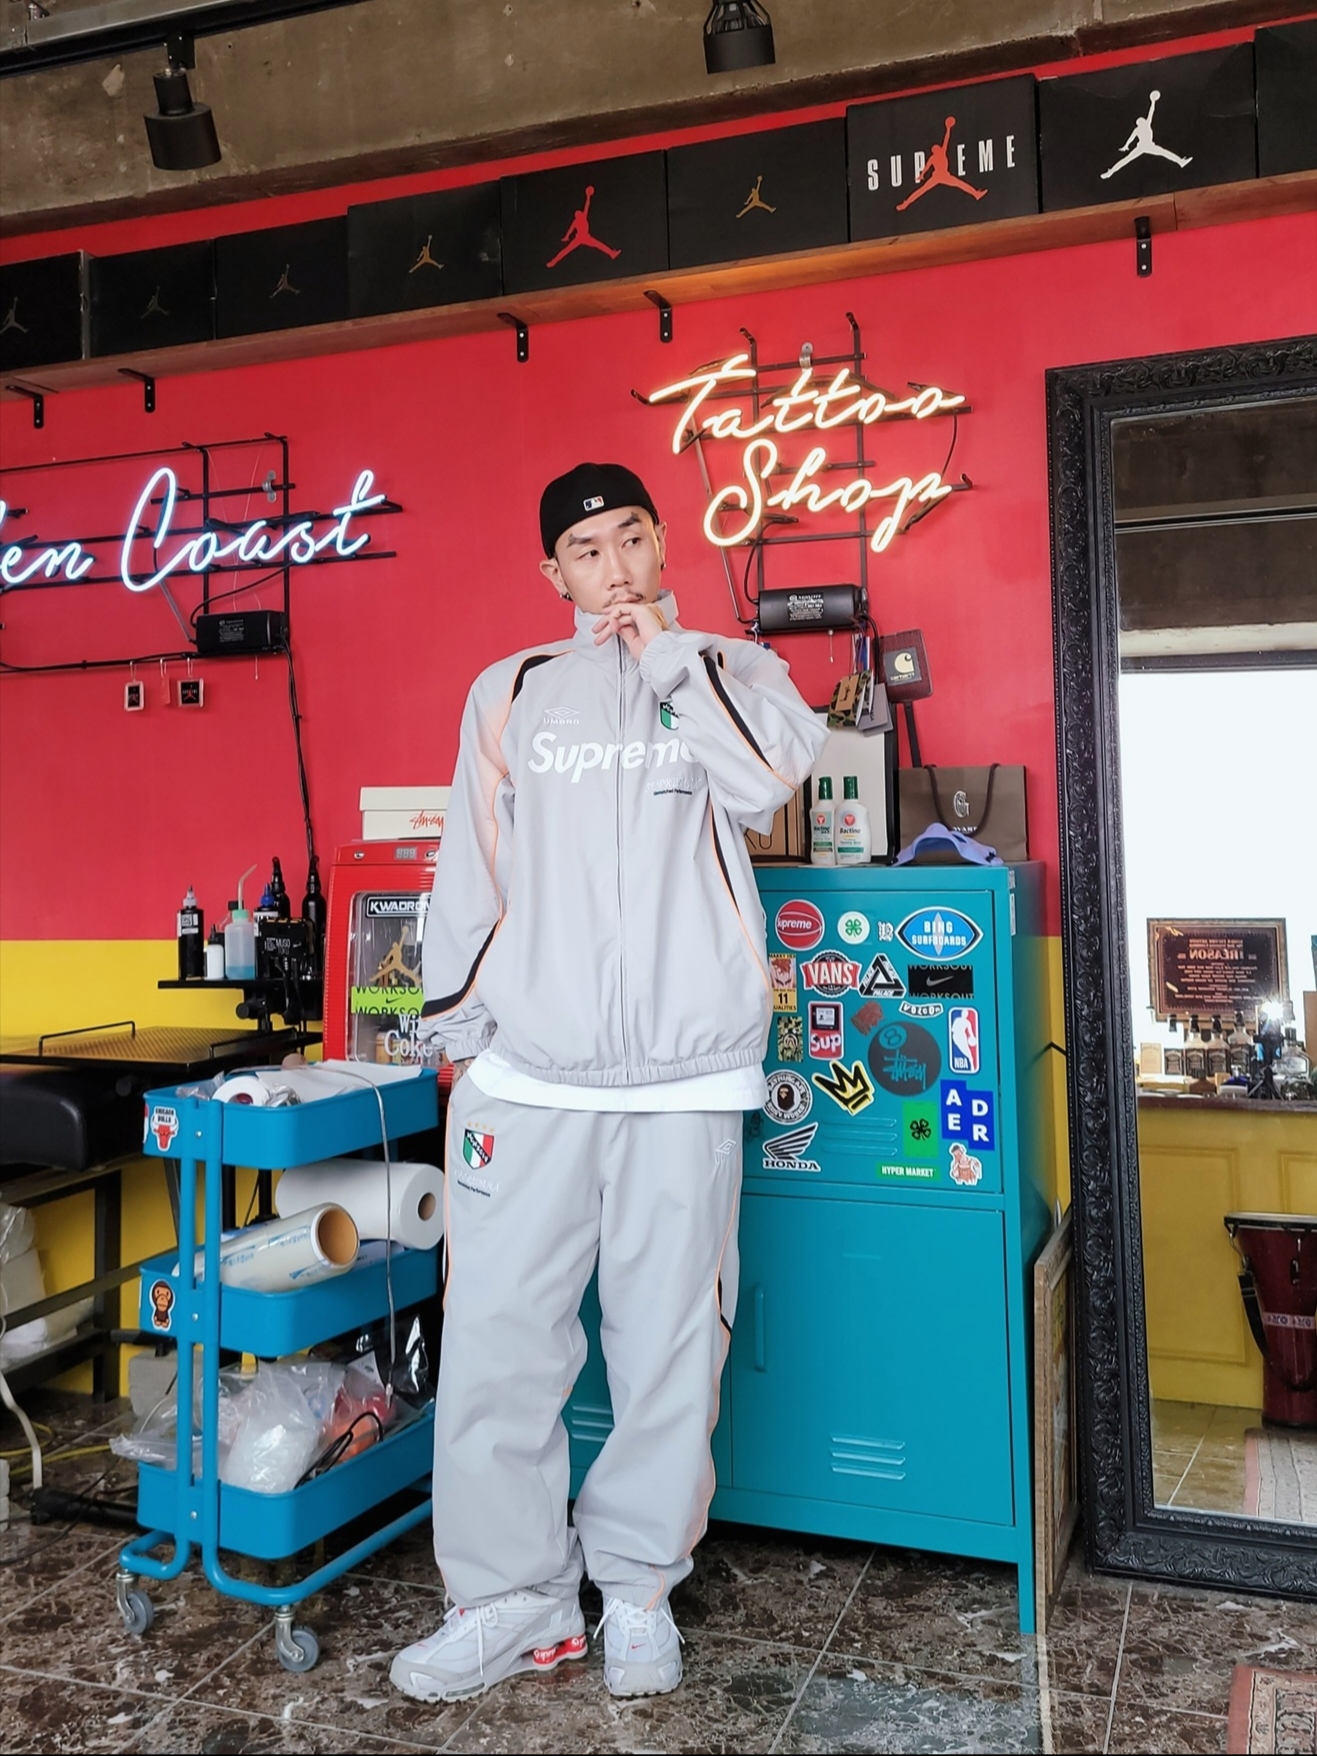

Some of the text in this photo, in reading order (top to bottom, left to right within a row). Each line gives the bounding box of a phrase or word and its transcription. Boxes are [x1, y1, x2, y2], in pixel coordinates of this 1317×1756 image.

[867, 134, 1015, 191] SUPEME
[649, 353, 966, 454] Tattoo
[702, 438, 952, 553] Shop
[120, 467, 387, 592] Coast
[924, 921, 953, 933] BING
[912, 935, 966, 946] SURFBOARDS
[808, 963, 854, 985] VANS
[778, 993, 788, 1004] 11
[384, 1030, 433, 1058] Coke
[811, 1034, 842, 1053] Sup
[954, 1058, 968, 1070] NBA
[765, 1160, 818, 1170] HONDA
[882, 1166, 934, 1178] HYPER MARKET
